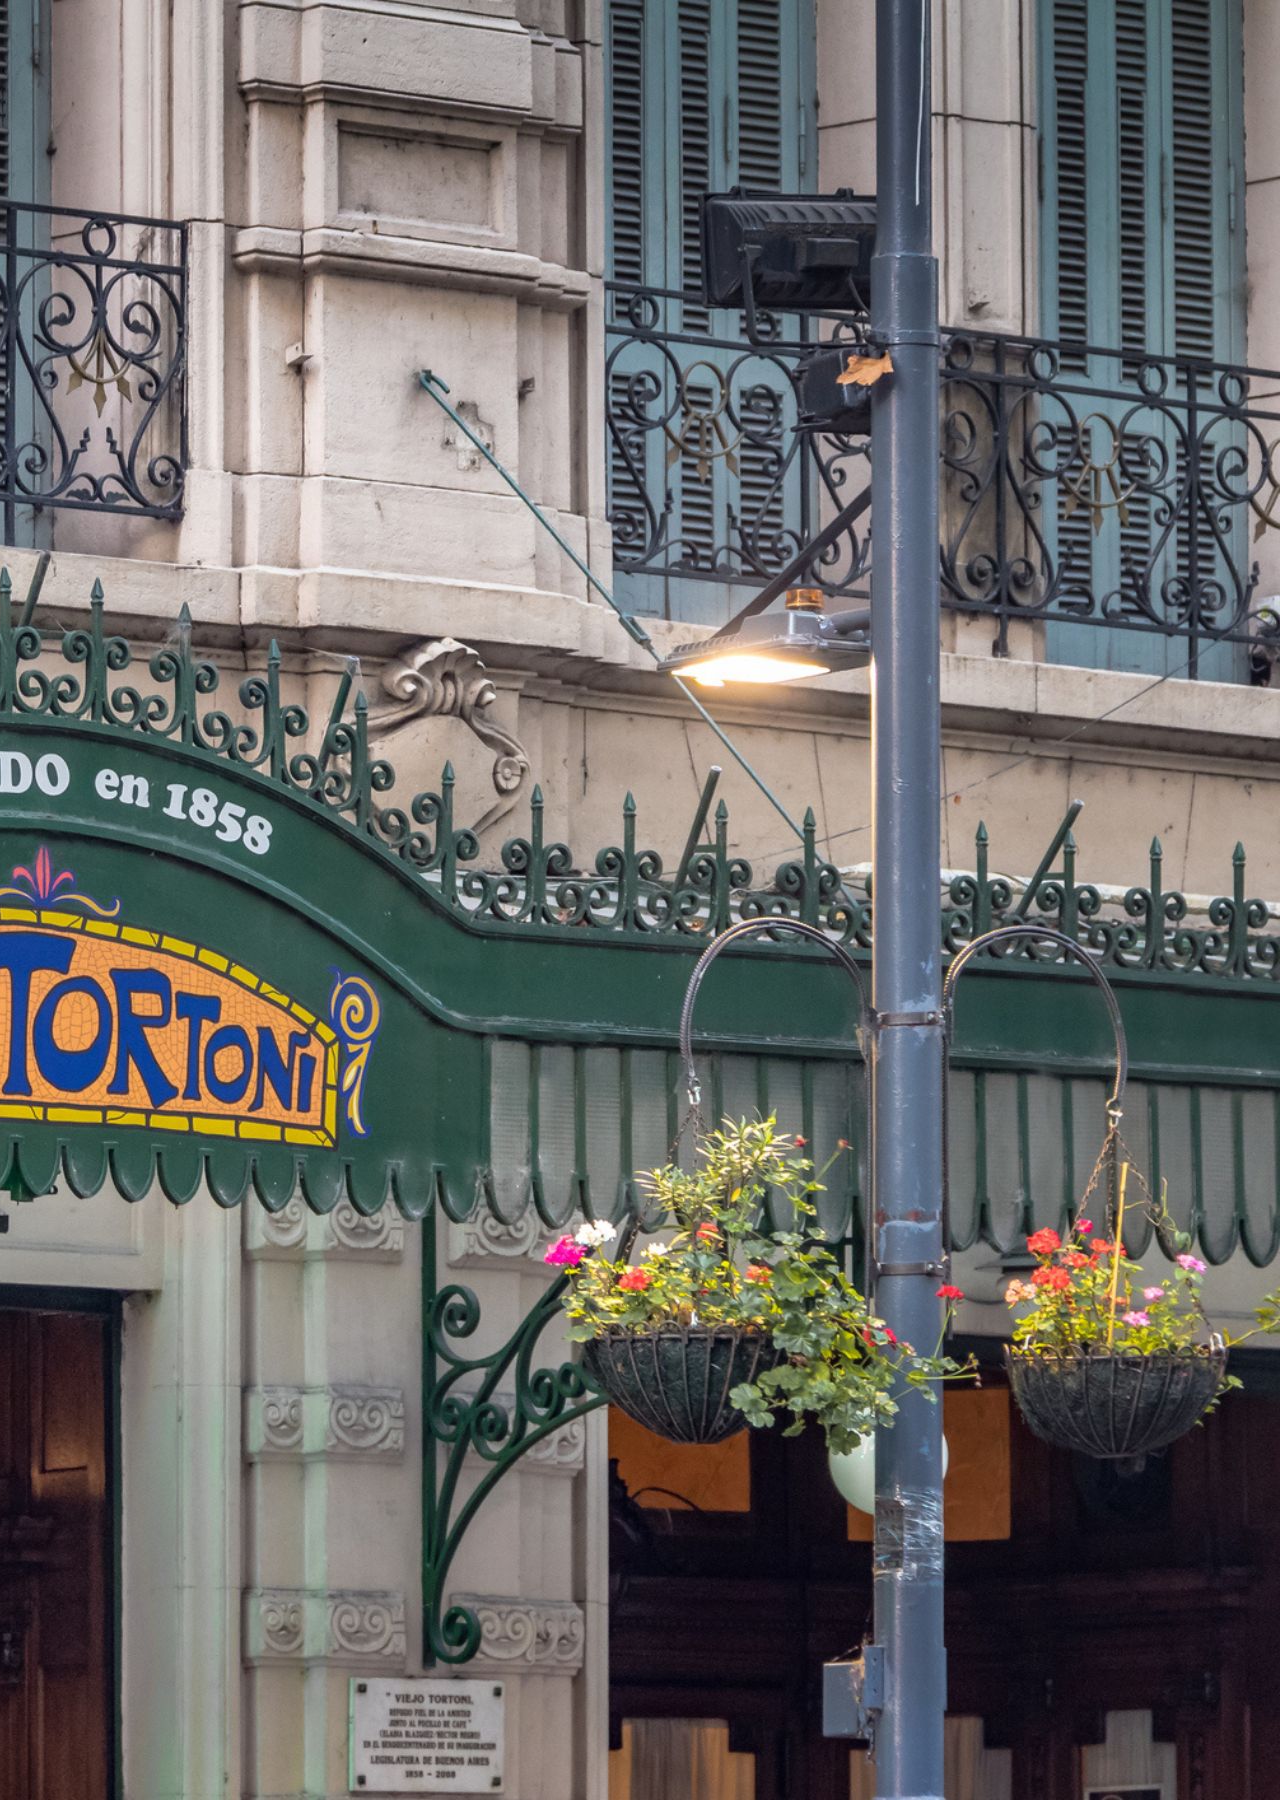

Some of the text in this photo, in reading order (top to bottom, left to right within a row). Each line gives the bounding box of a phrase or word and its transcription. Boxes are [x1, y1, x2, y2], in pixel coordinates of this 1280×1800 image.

[94, 767, 150, 809] en
[162, 781, 274, 856] 1858
[428, 1709, 435, 1717] DE
[388, 1719, 407, 1728] JUNTO
[408, 1719, 416, 1728] AL
[443, 1720, 450, 1728] DE
[363, 1740, 371, 1749] EN
[372, 1740, 380, 1749] EL
[437, 1741, 445, 1750] DE
[370, 1755, 490, 1767] LEGISLATURA DE BUENOS AIRES
[405, 1770, 424, 1778] 1858
[435, 1770, 456, 1779] 2008
